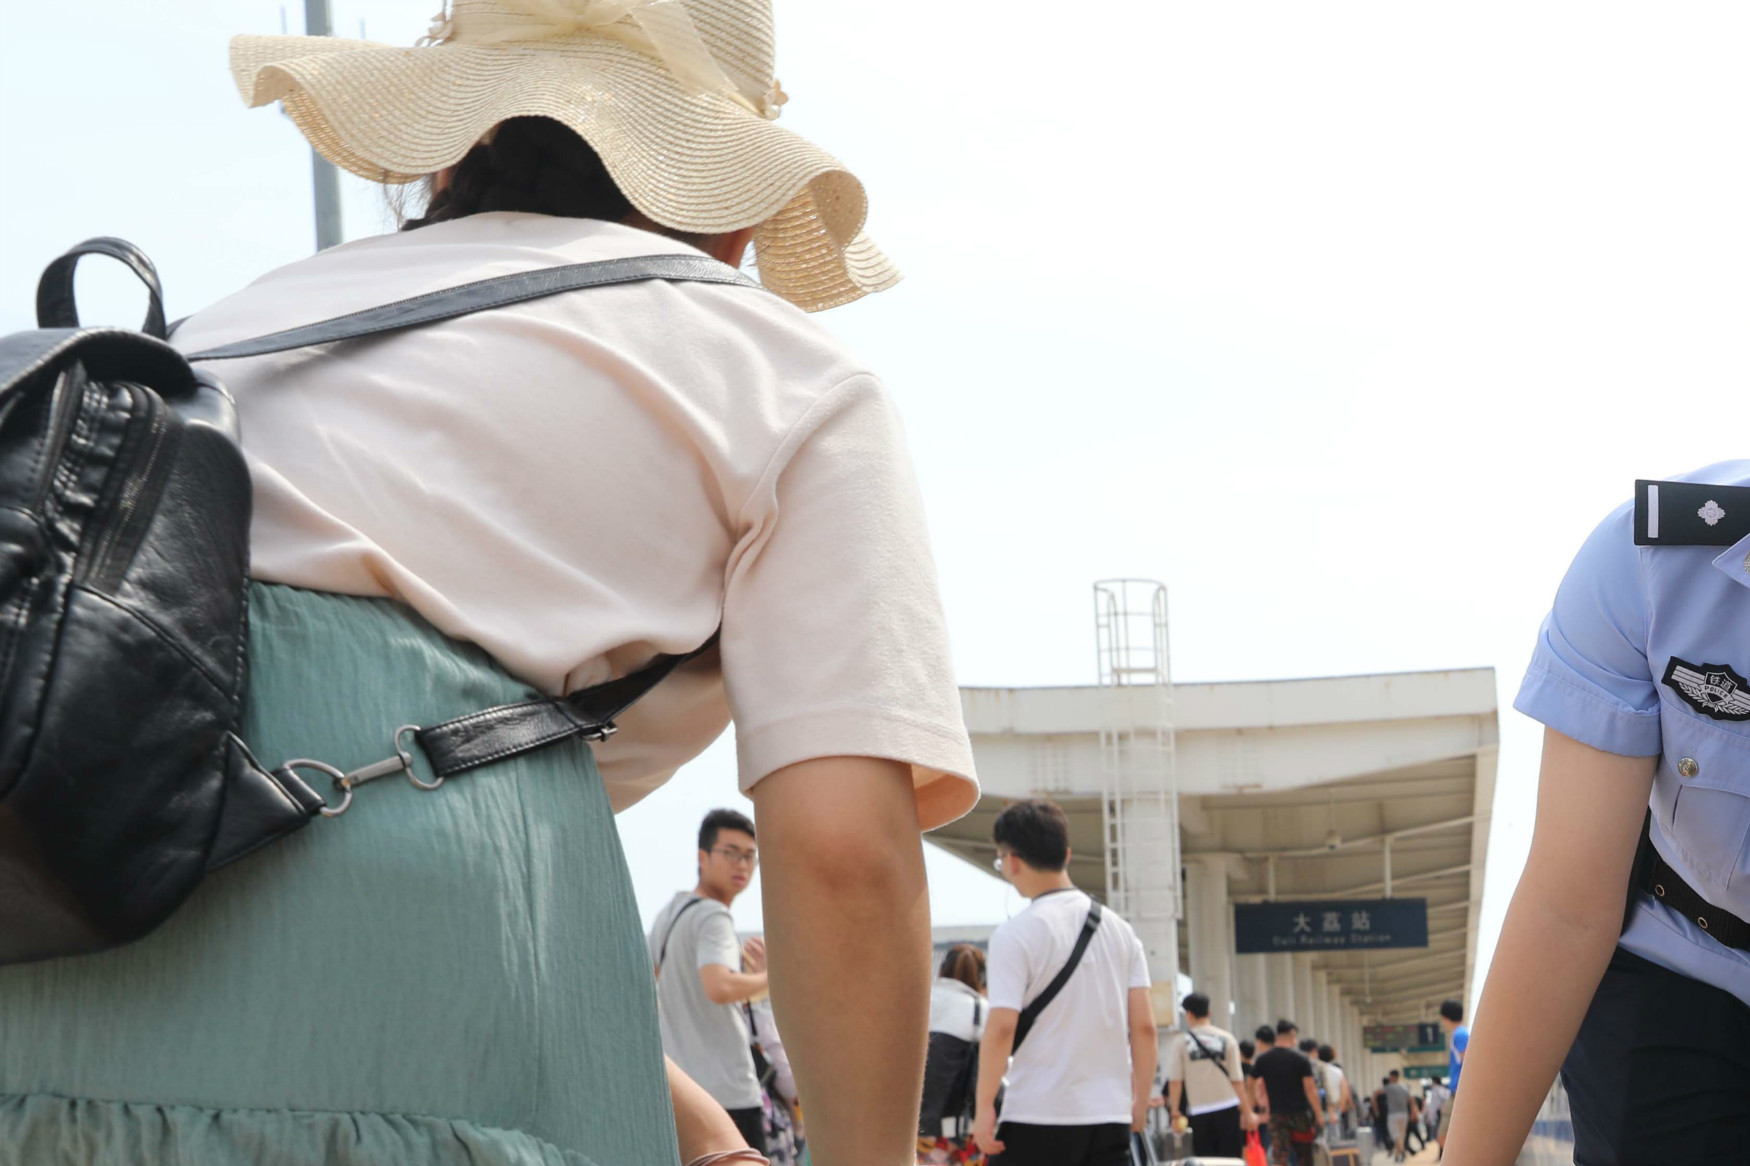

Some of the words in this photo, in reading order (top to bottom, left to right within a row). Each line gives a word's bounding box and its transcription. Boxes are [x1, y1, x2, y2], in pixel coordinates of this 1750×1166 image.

[1705, 684, 1729, 699] POLICE
[1710, 675, 1733, 692] 铁道
[1293, 912, 1371, 933] 大荔站
